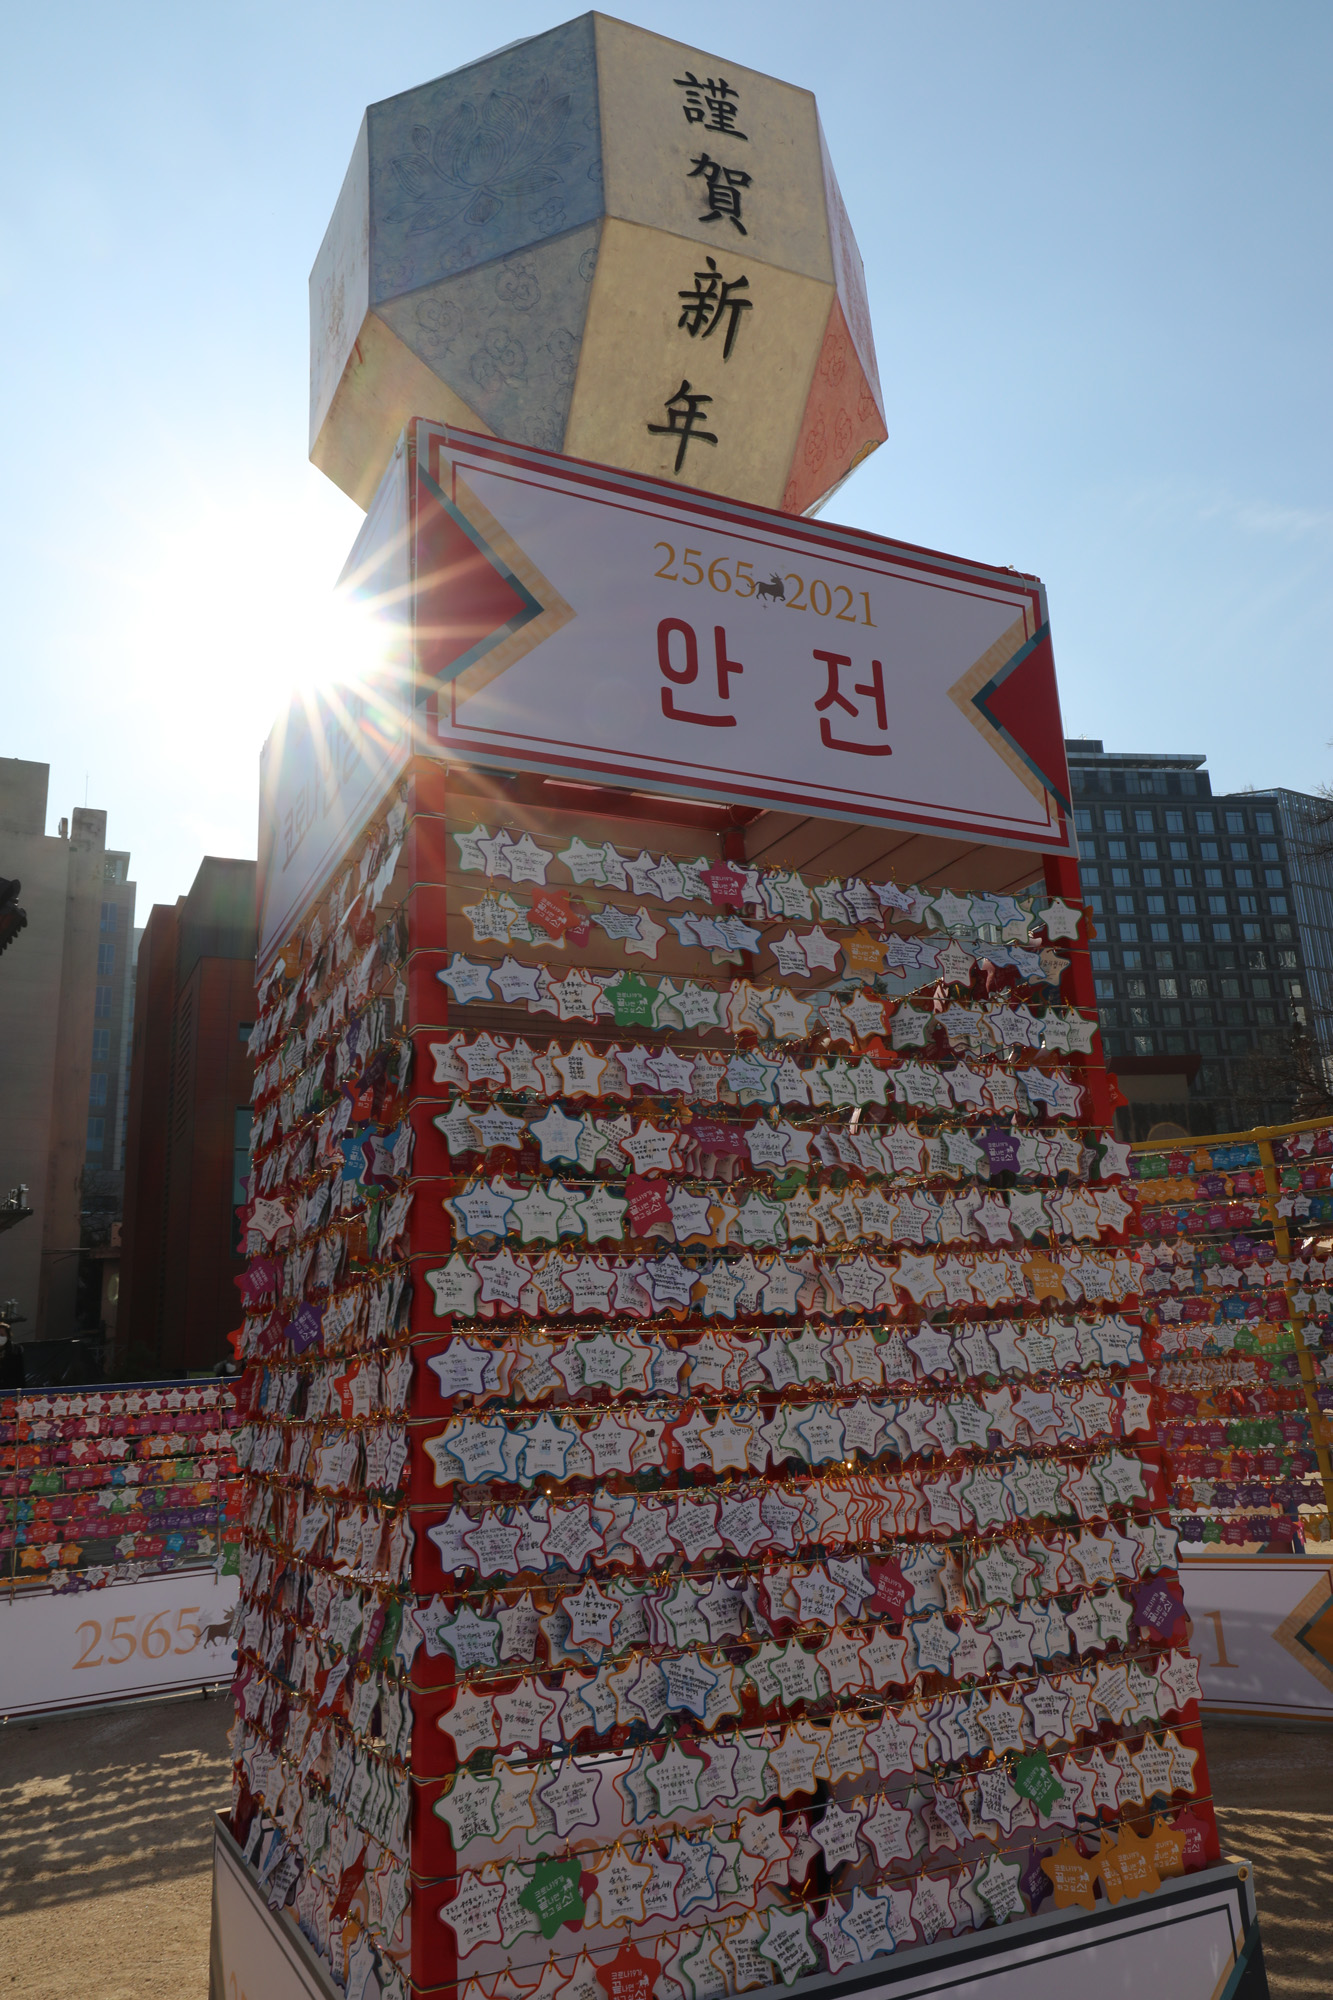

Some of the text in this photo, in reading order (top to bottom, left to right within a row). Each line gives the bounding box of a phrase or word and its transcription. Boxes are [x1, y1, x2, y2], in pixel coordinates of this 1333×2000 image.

[648, 71, 752, 476] 謹賀新年
[653, 541, 878, 628] 2565 2021
[72, 1606, 201, 1670] 2565
